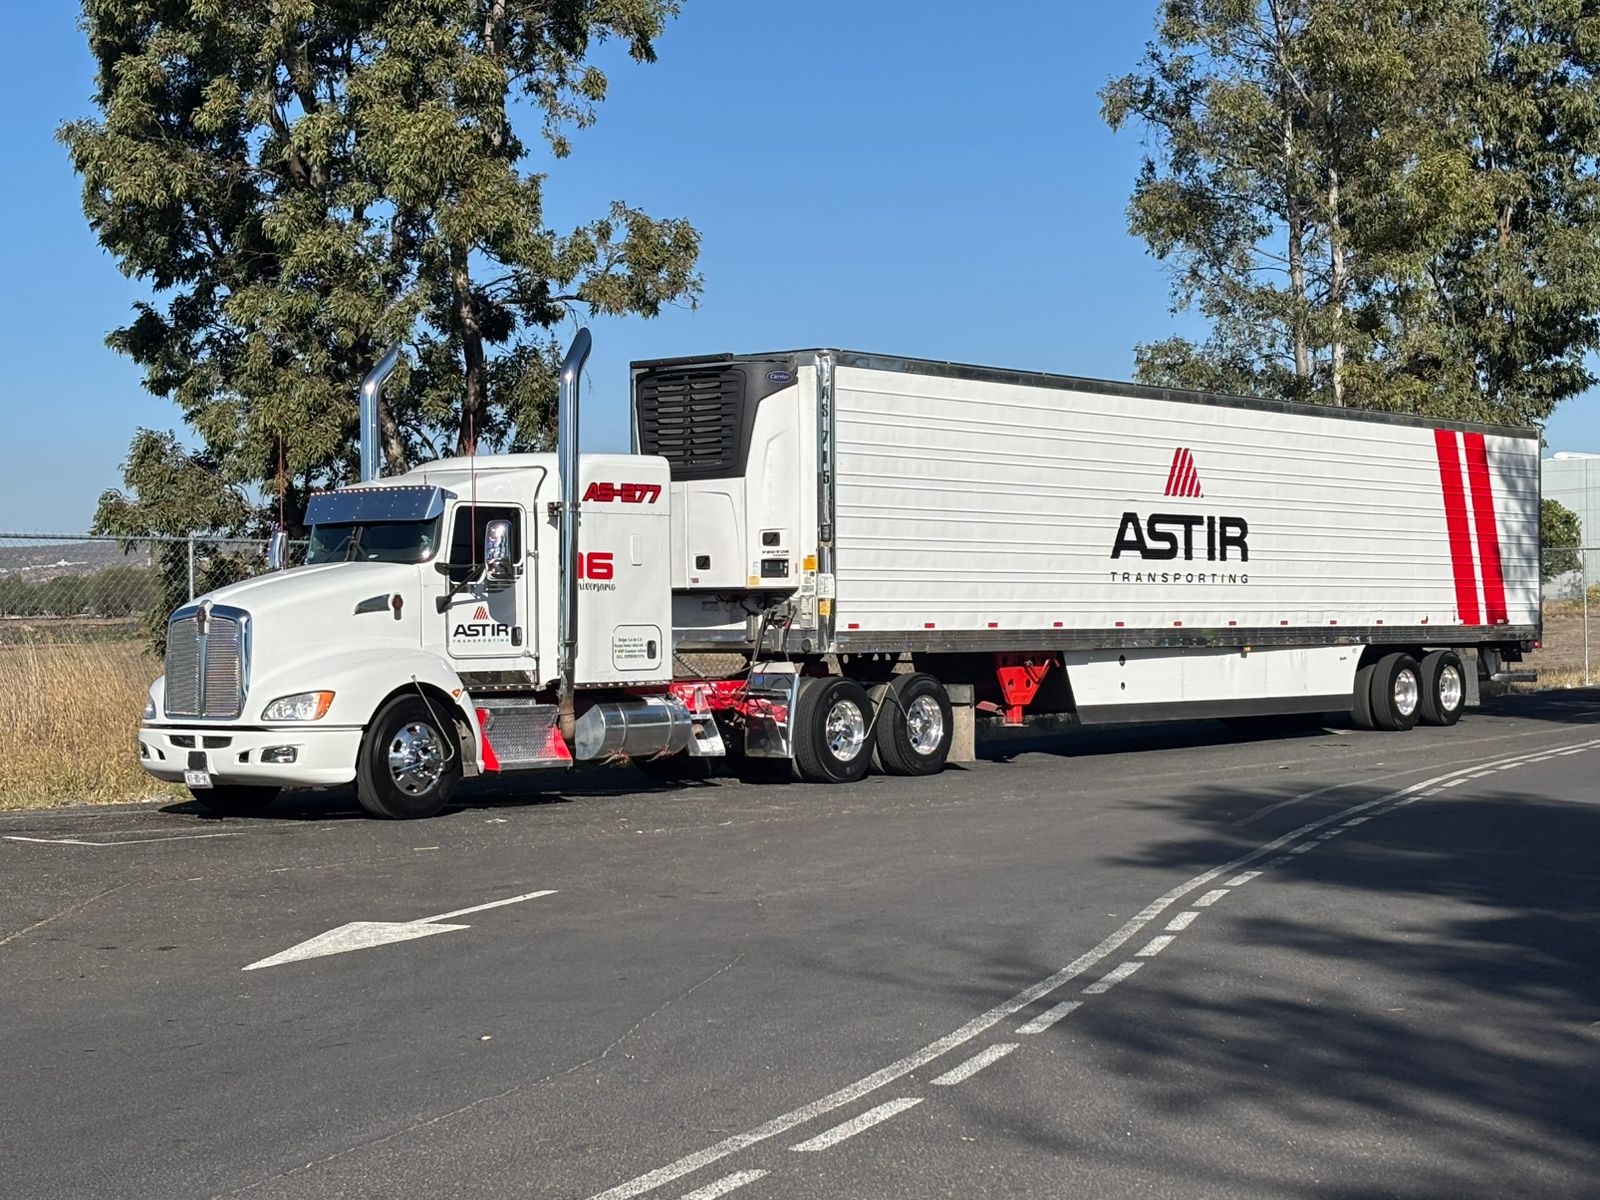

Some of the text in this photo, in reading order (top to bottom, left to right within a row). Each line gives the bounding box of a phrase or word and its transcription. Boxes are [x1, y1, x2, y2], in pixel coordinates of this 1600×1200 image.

[1110, 511, 1249, 562] ASTIR
[1110, 571, 1249, 584] TRANSPORTING
[577, 580, 616, 592] niversario
[453, 623, 509, 637] ASTIR
